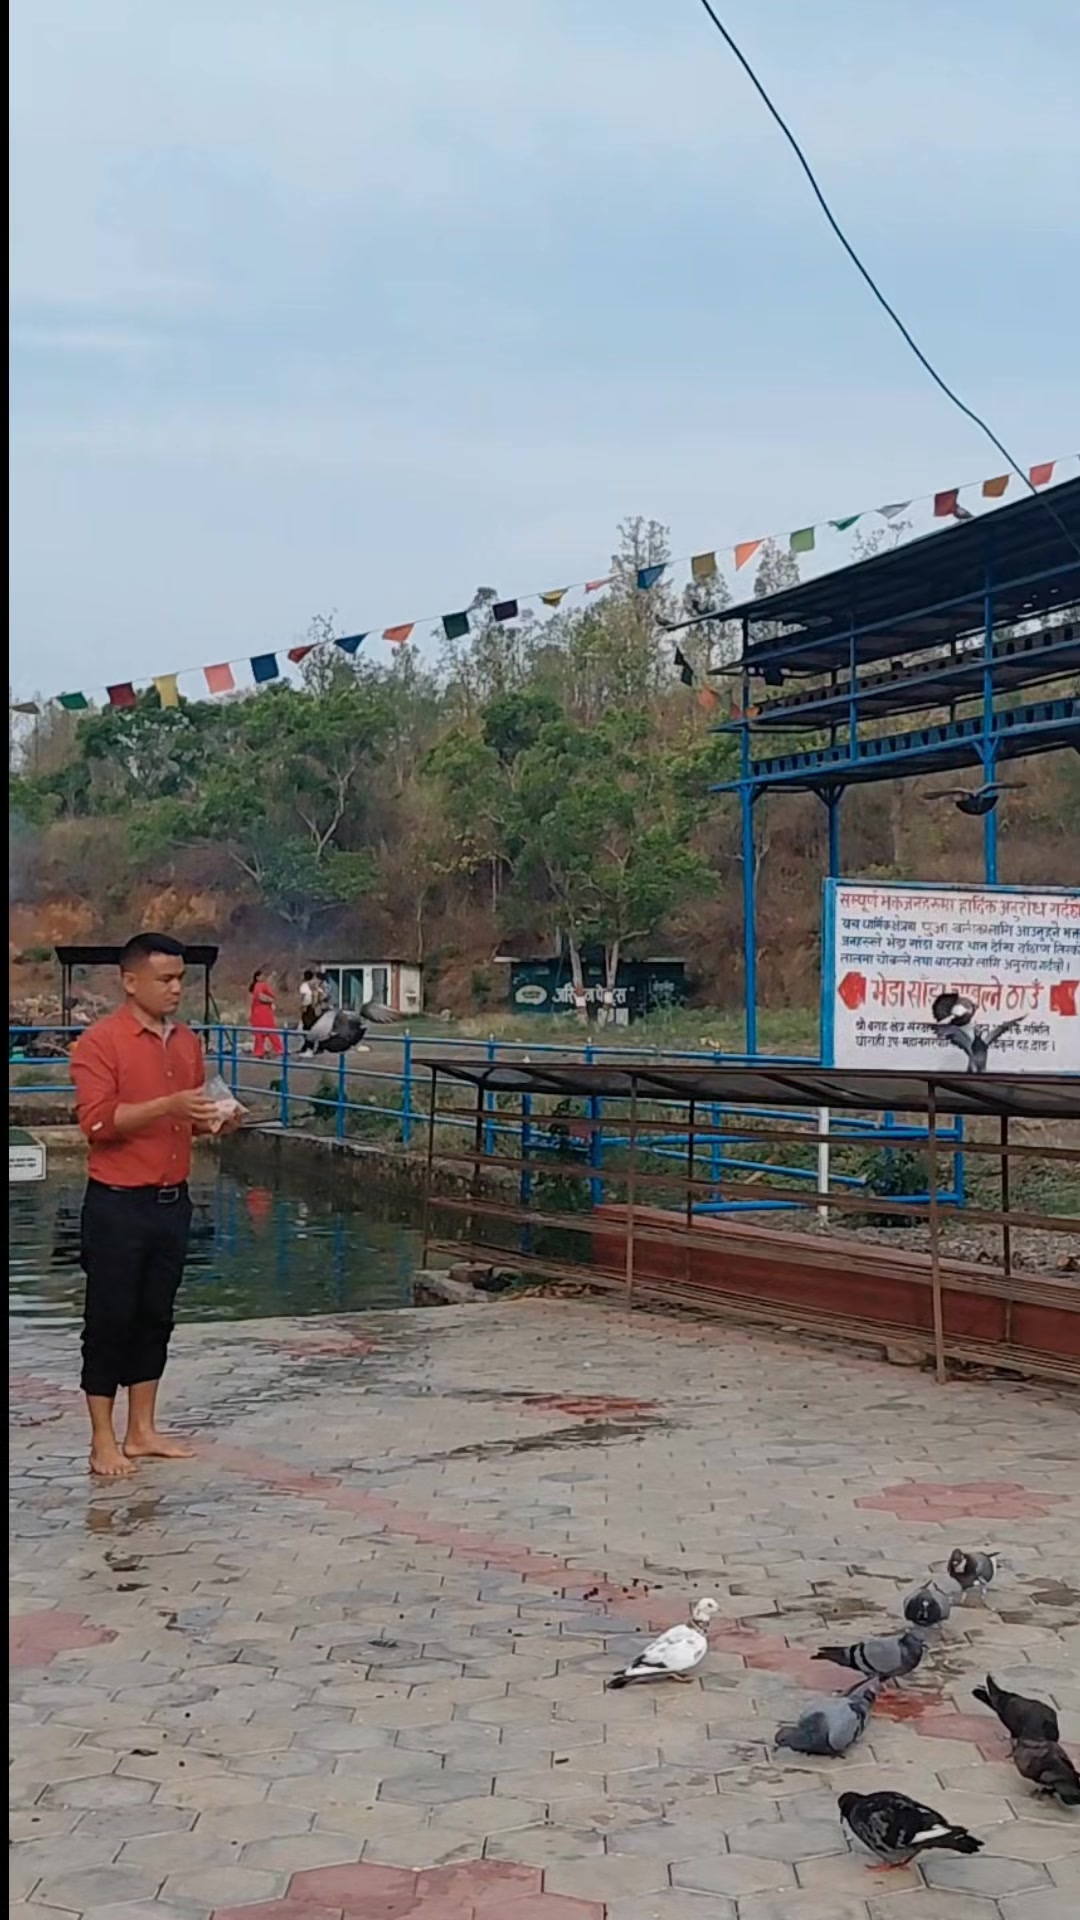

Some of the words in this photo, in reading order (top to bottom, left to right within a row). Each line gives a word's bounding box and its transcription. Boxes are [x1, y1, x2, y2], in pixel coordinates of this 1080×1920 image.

[1000, 896, 1046, 922] अनुरोध
[870, 971, 905, 1007] भेडा
[1006, 978, 1045, 1010] ठाउँ
